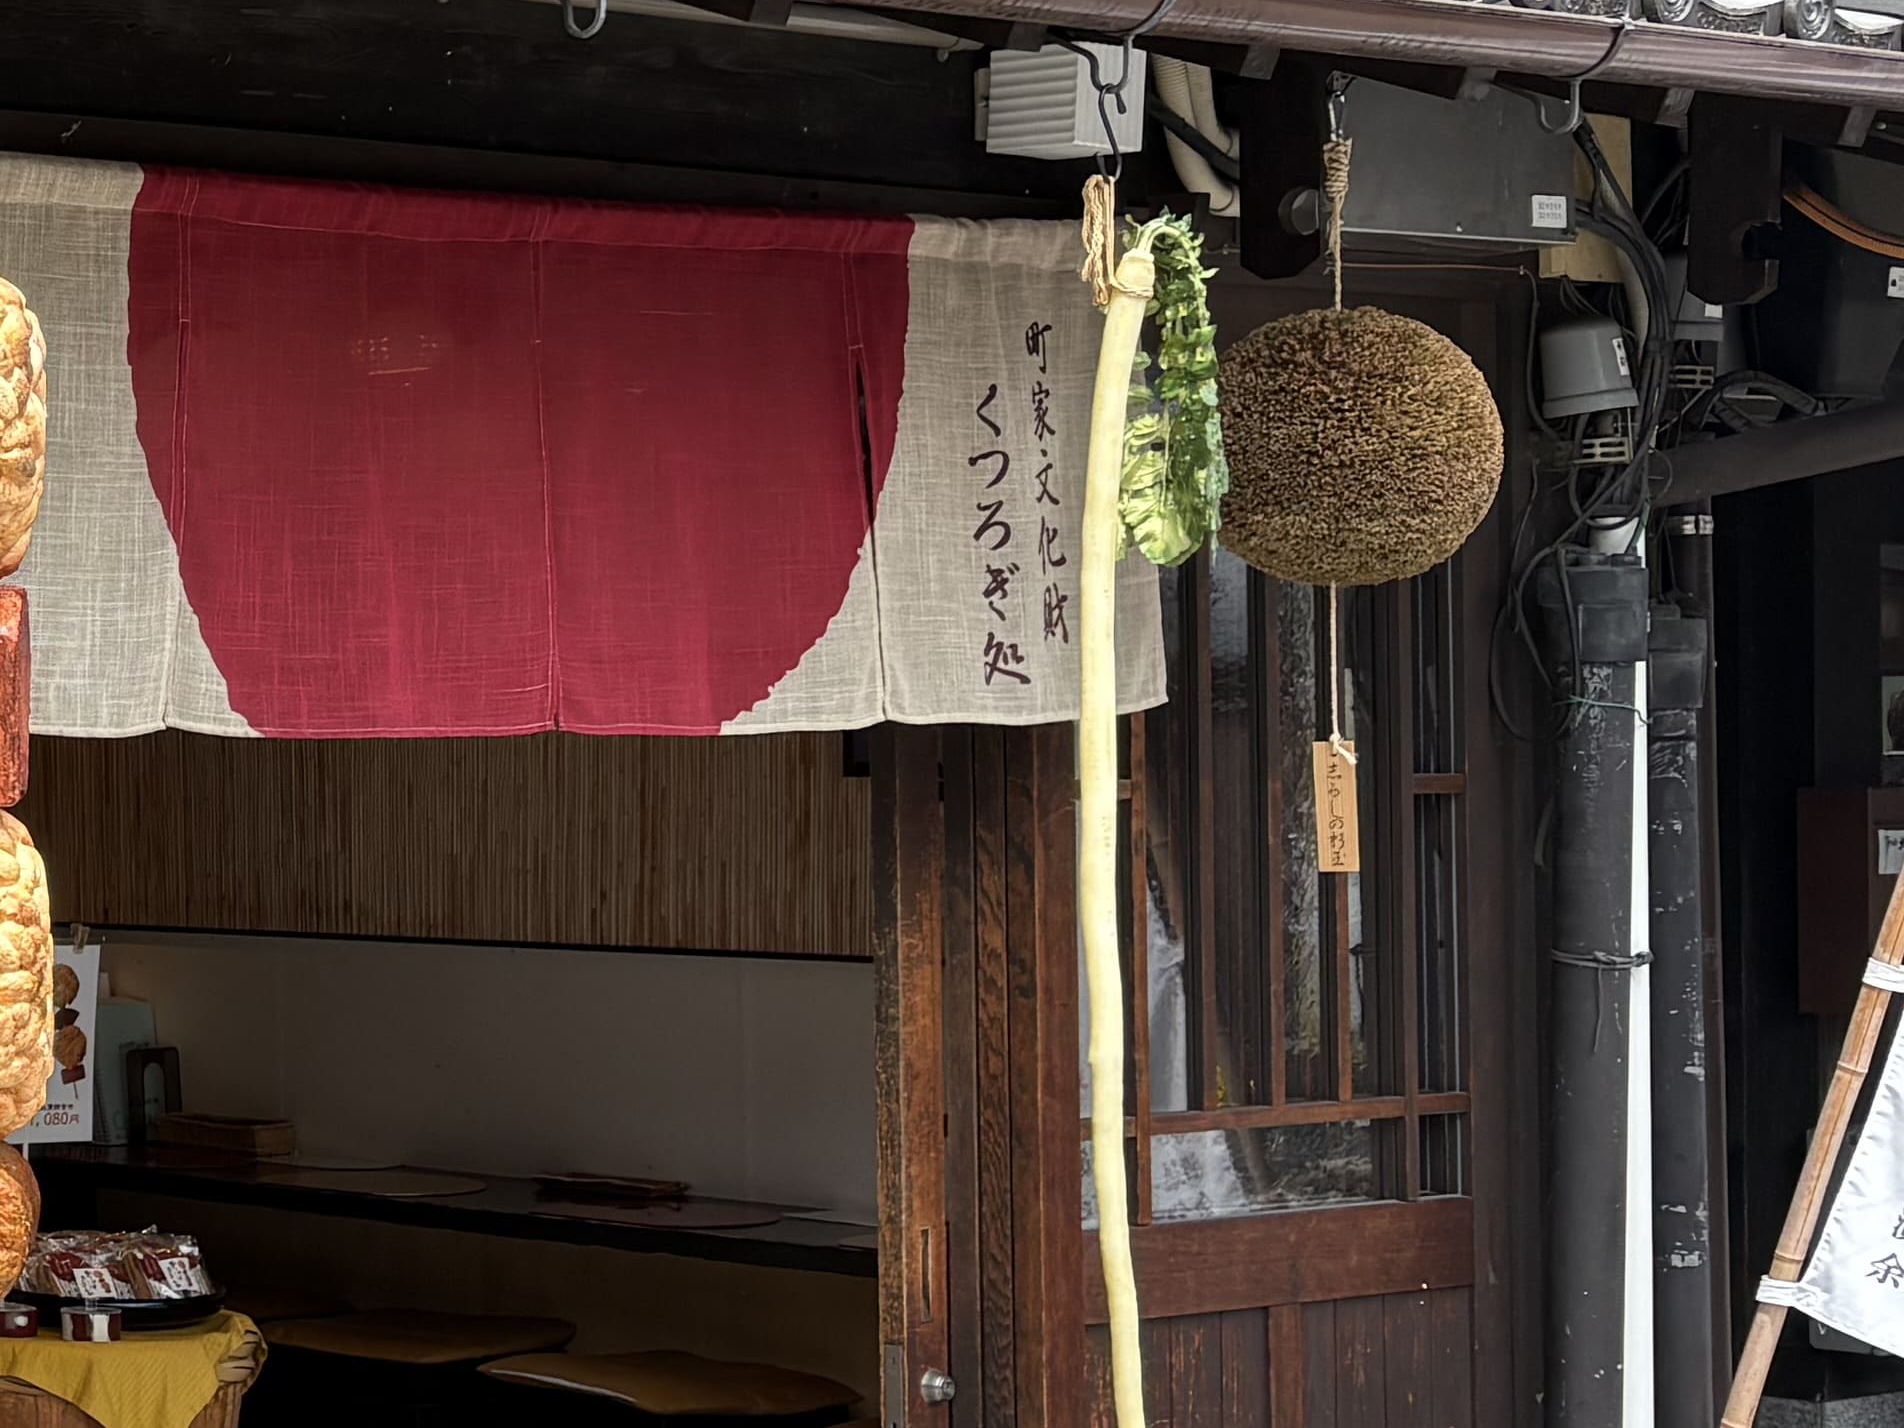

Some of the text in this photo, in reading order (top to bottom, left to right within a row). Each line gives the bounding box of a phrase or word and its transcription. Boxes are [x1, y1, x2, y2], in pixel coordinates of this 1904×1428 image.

[967, 382, 1032, 686] くつろぎ処
